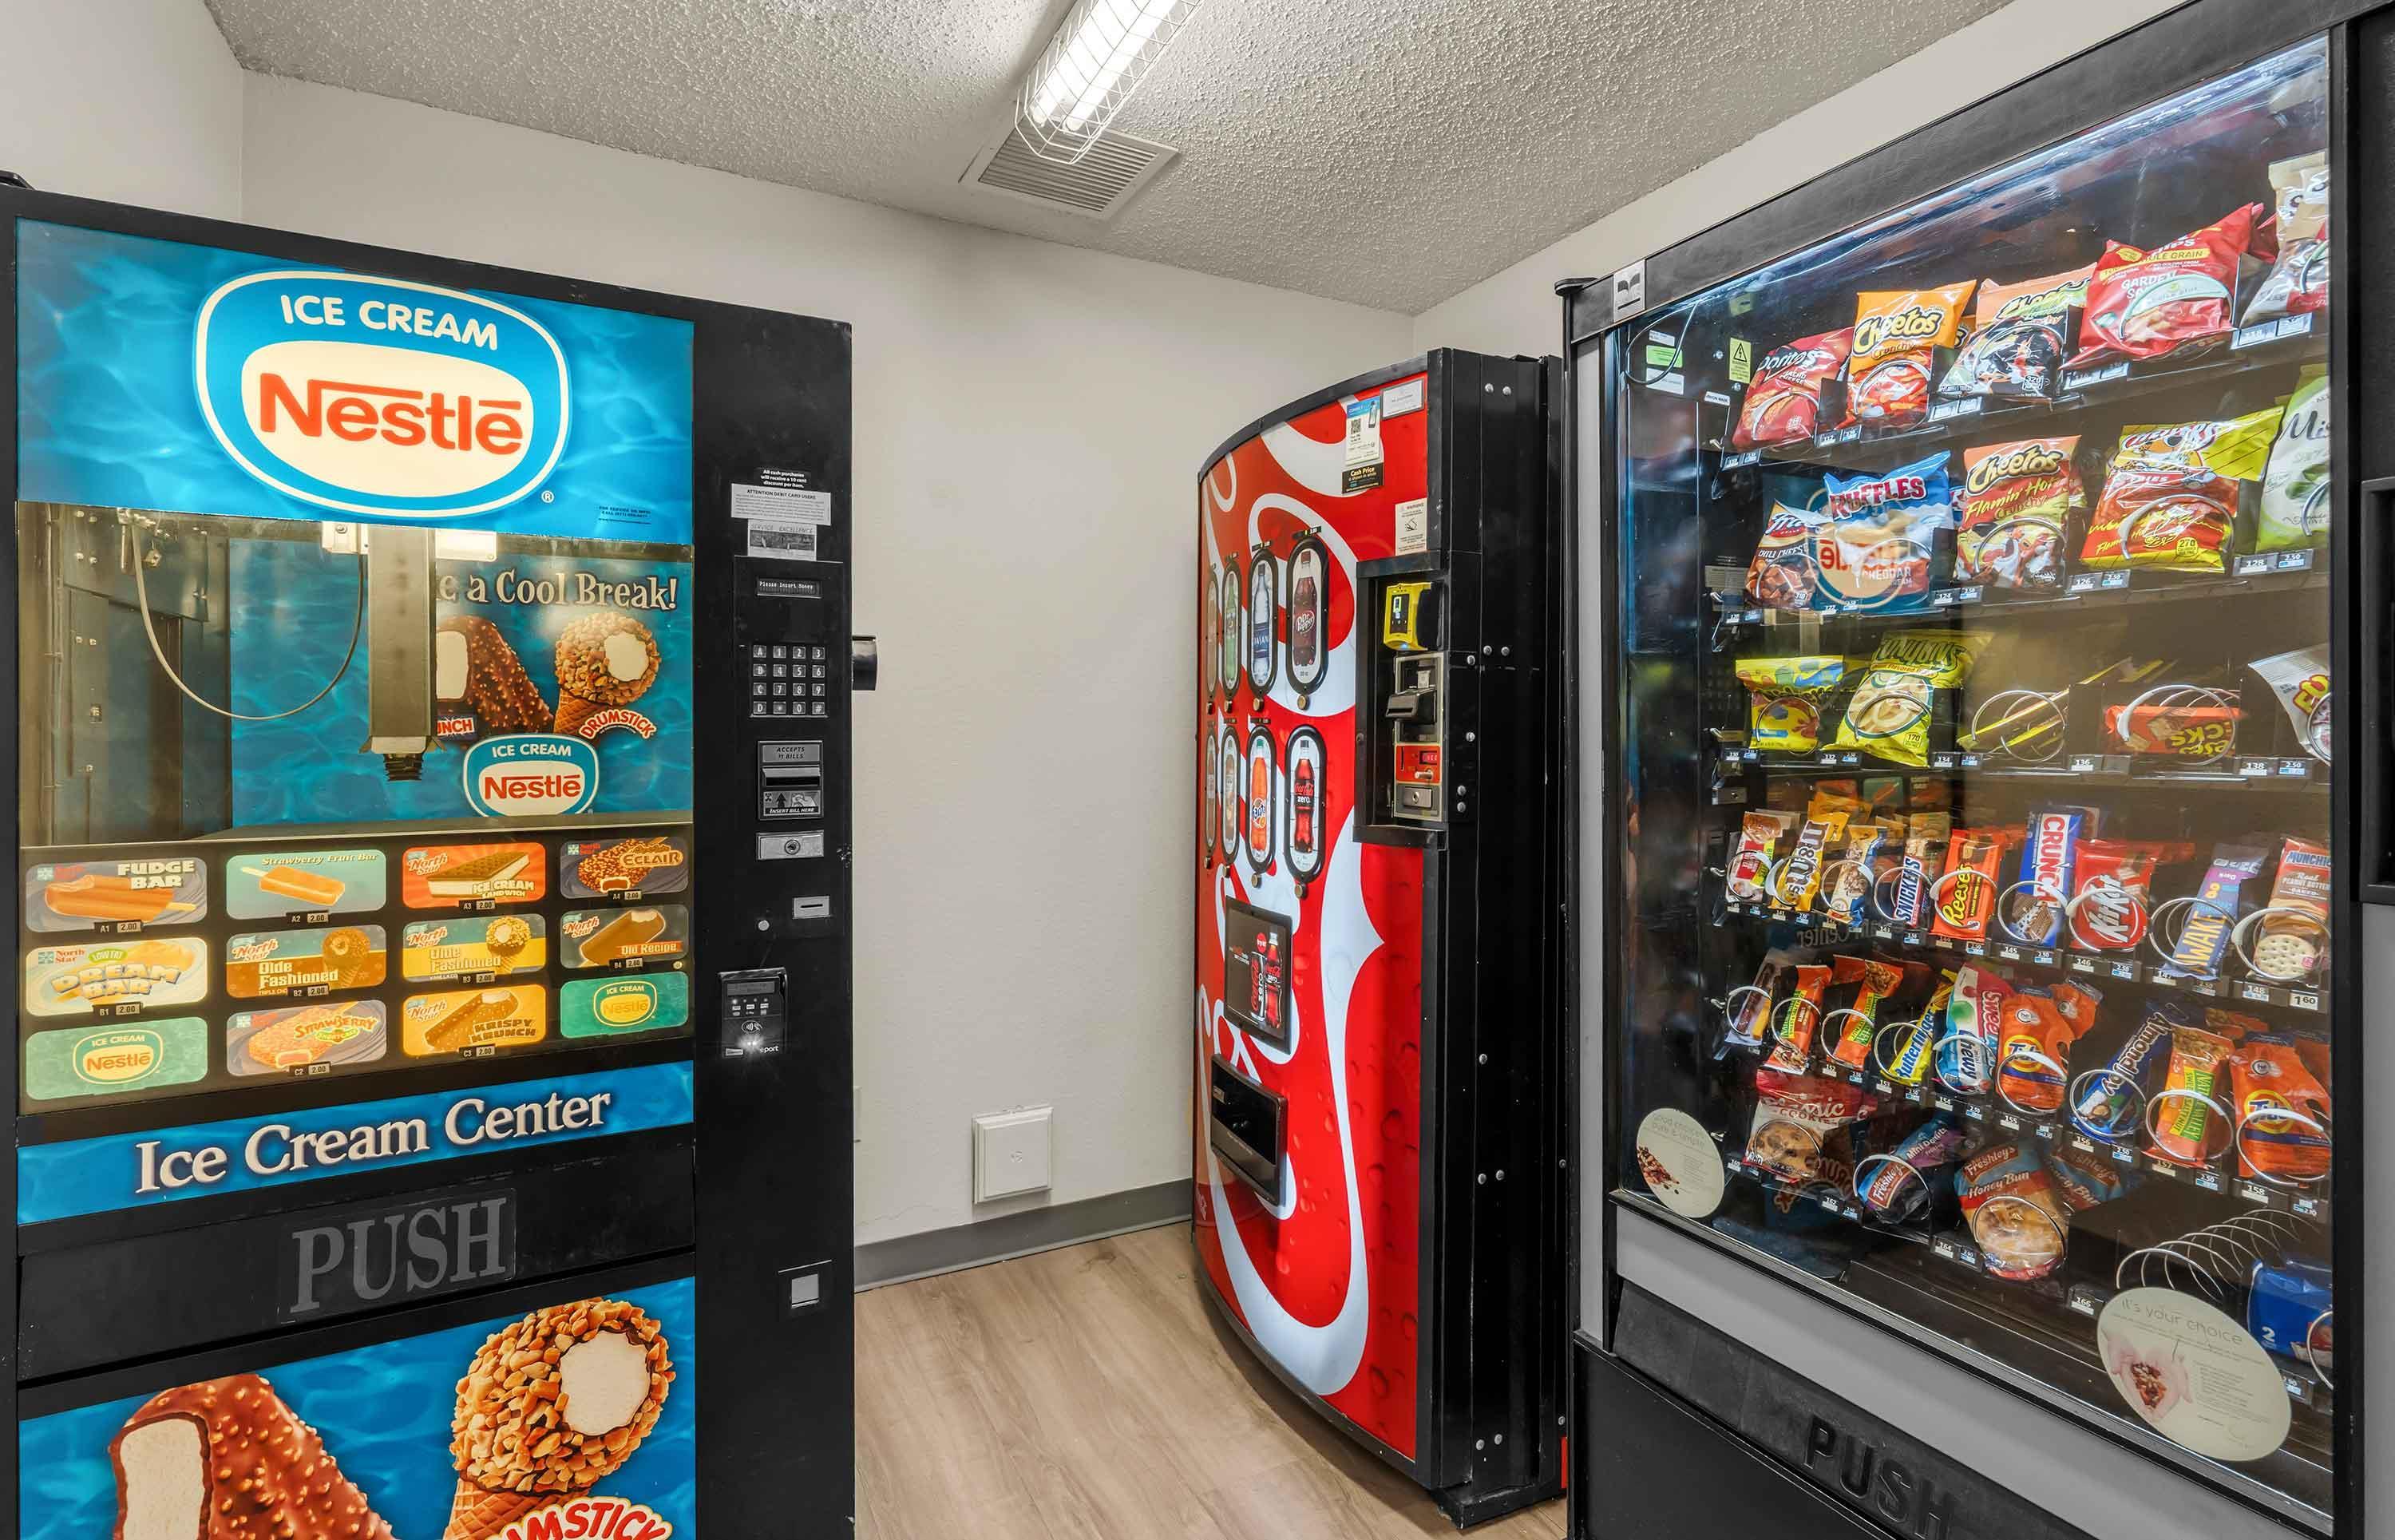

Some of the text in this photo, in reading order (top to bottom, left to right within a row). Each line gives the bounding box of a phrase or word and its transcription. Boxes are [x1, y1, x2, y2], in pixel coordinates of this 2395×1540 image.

[2171, 251, 2203, 260] GRAIN
[280, 294, 498, 351] ICE CREAM
[1852, 307, 1943, 355] Cheetos
[1871, 342, 1914, 360] Crunchy
[2026, 376, 2041, 385] 320
[1967, 445, 2064, 496] Cheetos
[1830, 477, 1927, 519] RUFFLES
[1965, 489, 2021, 522] Flamin'
[2179, 539, 2195, 548] 270
[1861, 567, 1912, 581] CHEDDAR
[468, 575, 489, 604] a
[497, 568, 567, 605] Cool
[576, 572, 678, 610] Break!
[798, 648, 802, 657] 2
[778, 667, 782, 675] 4
[817, 667, 821, 676] 6
[758, 703, 763, 712] D
[579, 710, 657, 739] DRUMSTICK
[493, 744, 572, 758] ICE CREAM
[261, 856, 324, 866] Strawberry
[408, 853, 448, 871] North
[623, 851, 681, 865] ECLAIR
[117, 860, 195, 876] FUDGE
[130, 876, 183, 890] BAR
[473, 880, 534, 894] ICE CREAM
[1894, 857, 1922, 922] SNICKERS
[100, 923, 137, 933] A1 2.00
[563, 916, 600, 935] North
[55, 948, 86, 957] North
[232, 939, 279, 959] North
[621, 943, 677, 955] Old Recipe
[259, 961, 292, 974] Olde
[259, 969, 338, 990] Fashioned
[2247, 986, 2265, 995] 148
[474, 1019, 533, 1033] KRISPY
[110, 1035, 145, 1043] CREAM
[471, 1028, 536, 1043] KRUNCH
[2005, 1115, 2018, 1124] 155
[136, 1091, 612, 1194] Ice Cream Center
[2076, 1137, 2091, 1146] 156
[1906, 1146, 1924, 1160] Mini
[1965, 1145, 2017, 1177] Freshley's
[1968, 1170, 2031, 1199] Honey Bun
[2247, 1186, 2266, 1195] 158
[1938, 1242, 1952, 1252] 164
[289, 1198, 509, 1314] PUSH
[2076, 1297, 2092, 1307] 166
[2262, 1326, 2275, 1341] 2
[1803, 1412, 1956, 1540] PUSH
